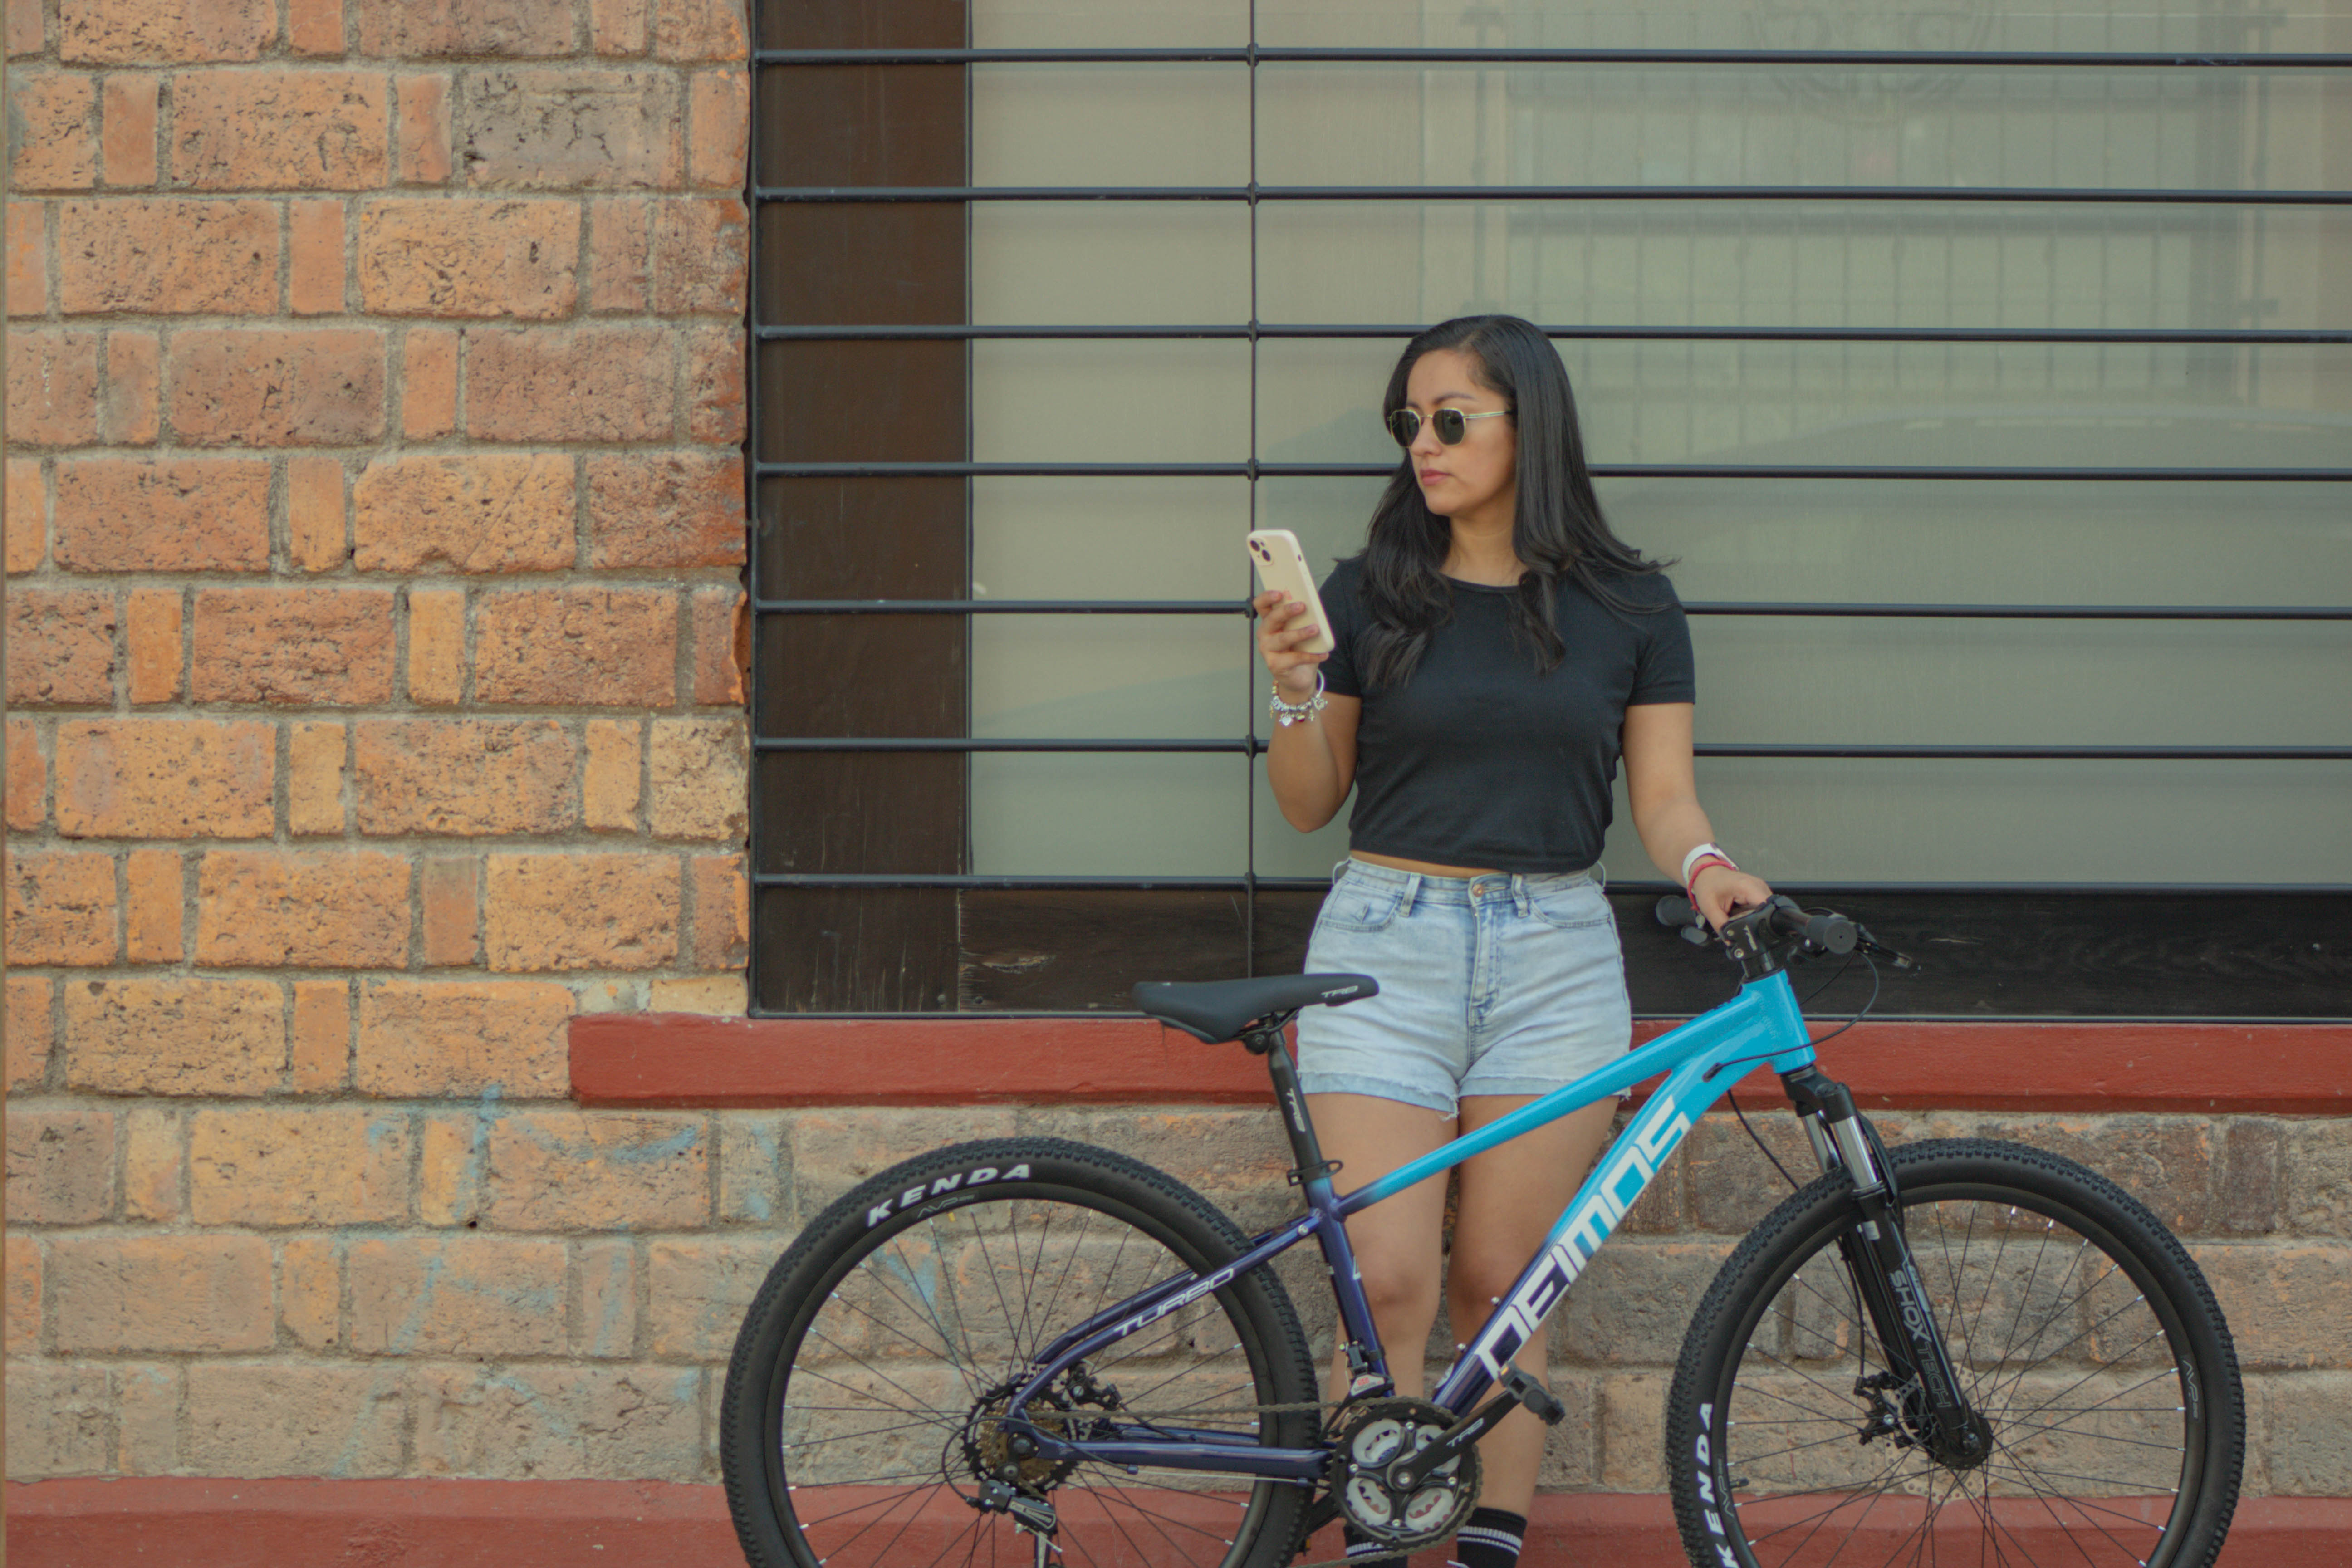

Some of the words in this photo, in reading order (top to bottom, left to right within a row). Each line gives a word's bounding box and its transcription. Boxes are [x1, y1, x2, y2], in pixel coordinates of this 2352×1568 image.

[868, 1164, 1029, 1227] KENDA
[1114, 1268, 1234, 1336] TURBO
[1890, 1270, 1932, 1342] SHOX
[1917, 1341, 1951, 1407] TECH
[1696, 1404, 1739, 1568] KENDA
